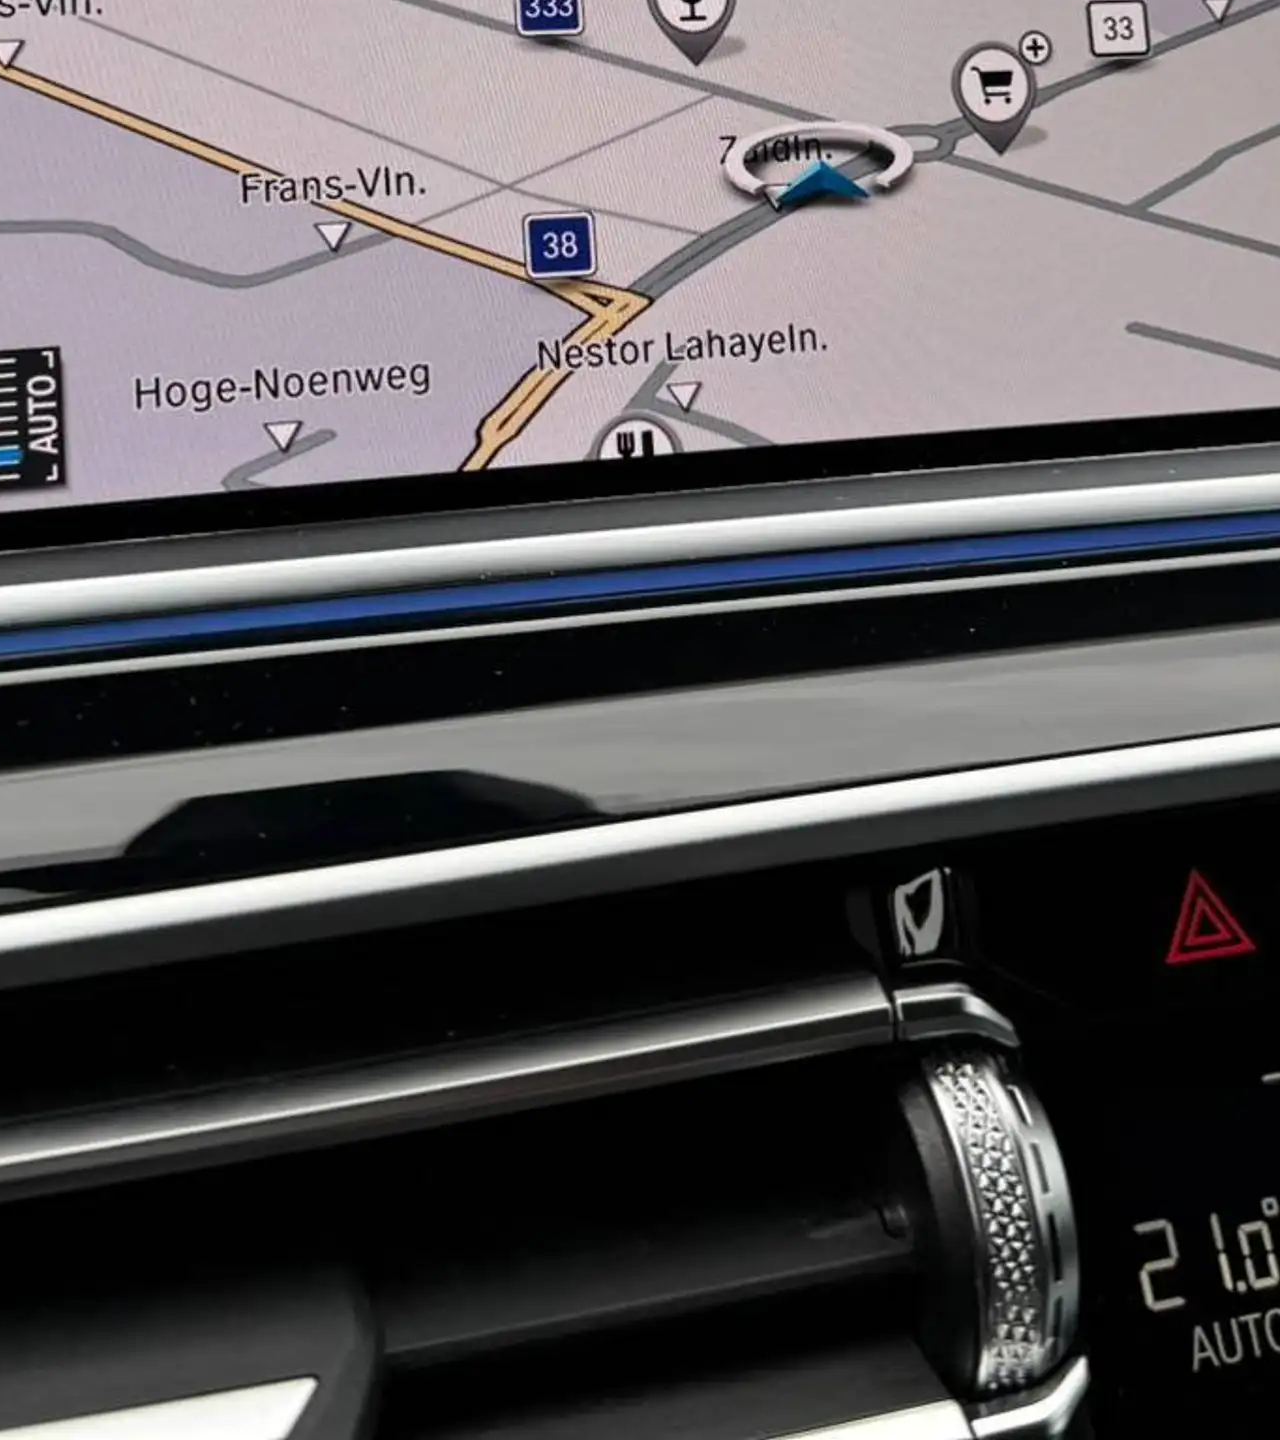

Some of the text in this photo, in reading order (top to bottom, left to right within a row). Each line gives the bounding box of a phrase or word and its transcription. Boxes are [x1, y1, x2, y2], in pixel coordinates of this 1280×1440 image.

[1103, 14, 1134, 43] 33
[241, 172, 426, 204] Frans-Vln.
[542, 230, 578, 260] 38
[537, 324, 828, 369] Nestor Lahayeln.
[134, 364, 431, 410] Hoge-Noenweg
[26, 375, 59, 454] AUTO
